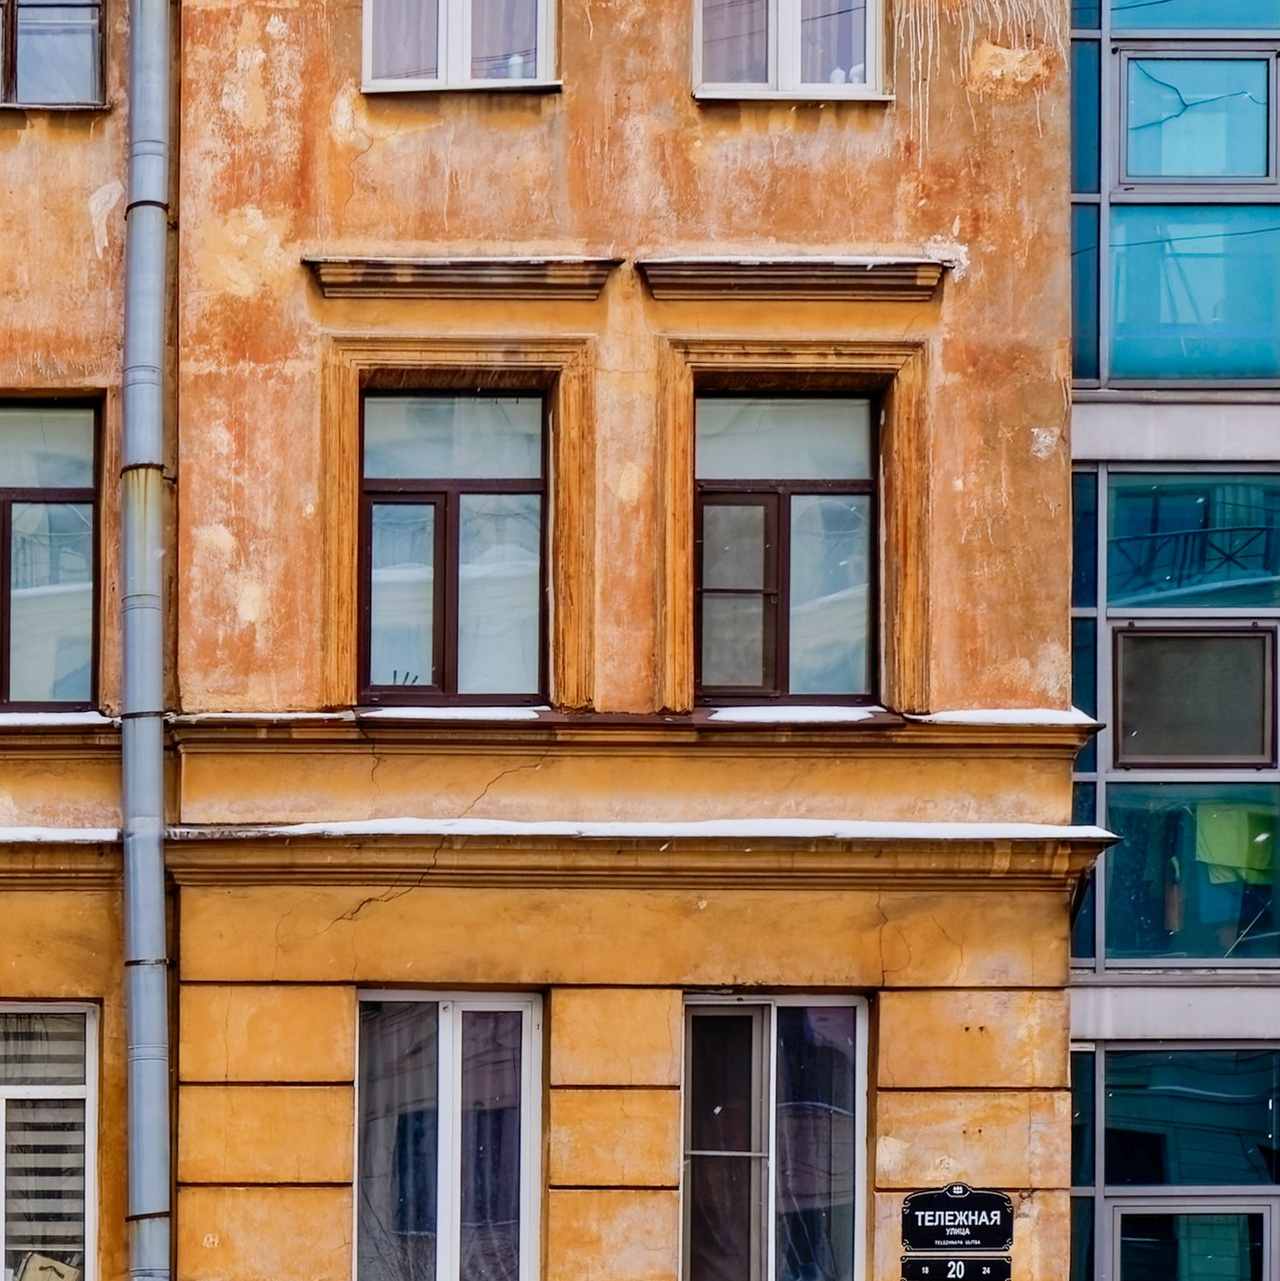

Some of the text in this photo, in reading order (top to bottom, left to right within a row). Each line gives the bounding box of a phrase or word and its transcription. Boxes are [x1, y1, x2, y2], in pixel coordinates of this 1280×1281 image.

[915, 1210, 1001, 1226] ТЕЛЕЖНАЯ
[946, 1227, 970, 1236] УЛИЦА
[921, 1261, 991, 1278] 18 20 24
